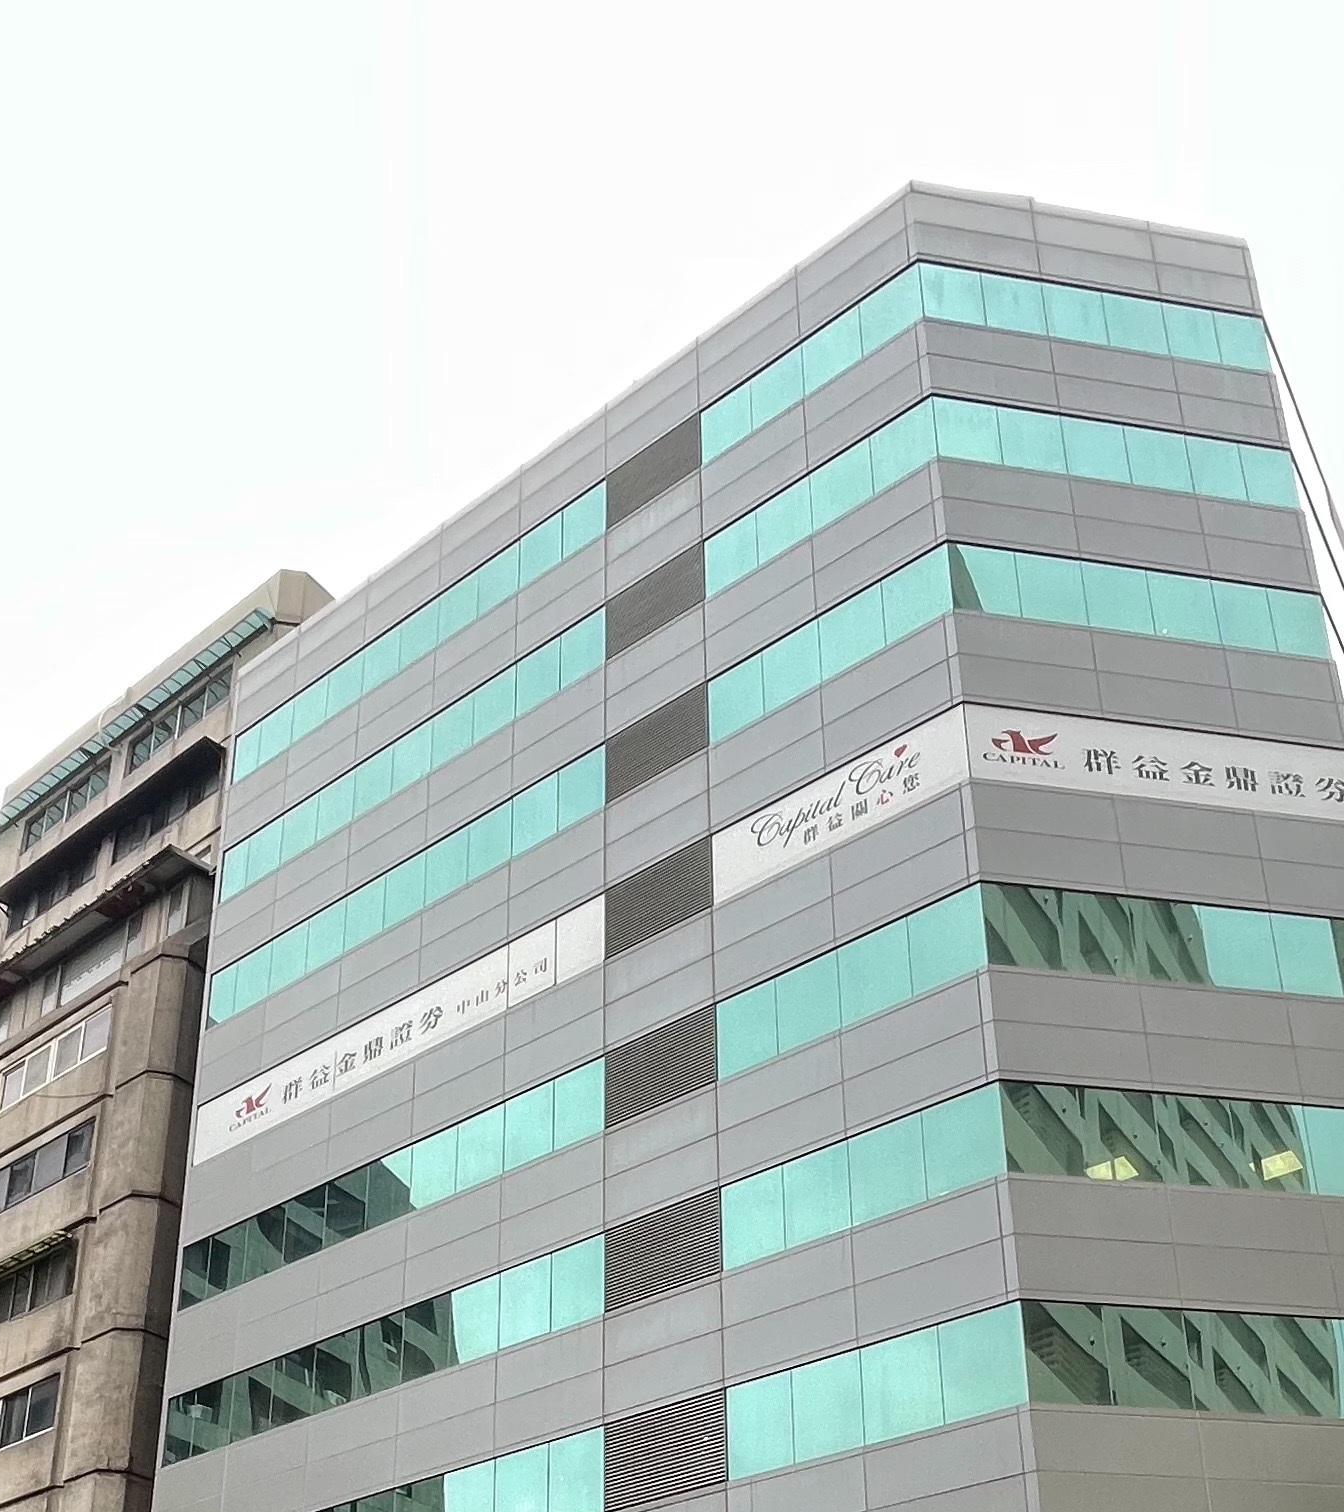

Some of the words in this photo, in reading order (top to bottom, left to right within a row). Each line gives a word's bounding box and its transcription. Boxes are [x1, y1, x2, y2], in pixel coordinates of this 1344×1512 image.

[982, 751, 1066, 770] CAPITAL
[750, 780, 847, 849] Capital
[848, 751, 921, 796] Care
[803, 773, 921, 845] 群益關心您
[283, 1005, 443, 1104] 群益金鼎證券
[456, 956, 549, 1015] 中山分公司
[228, 1105, 273, 1133] CAPITAL
